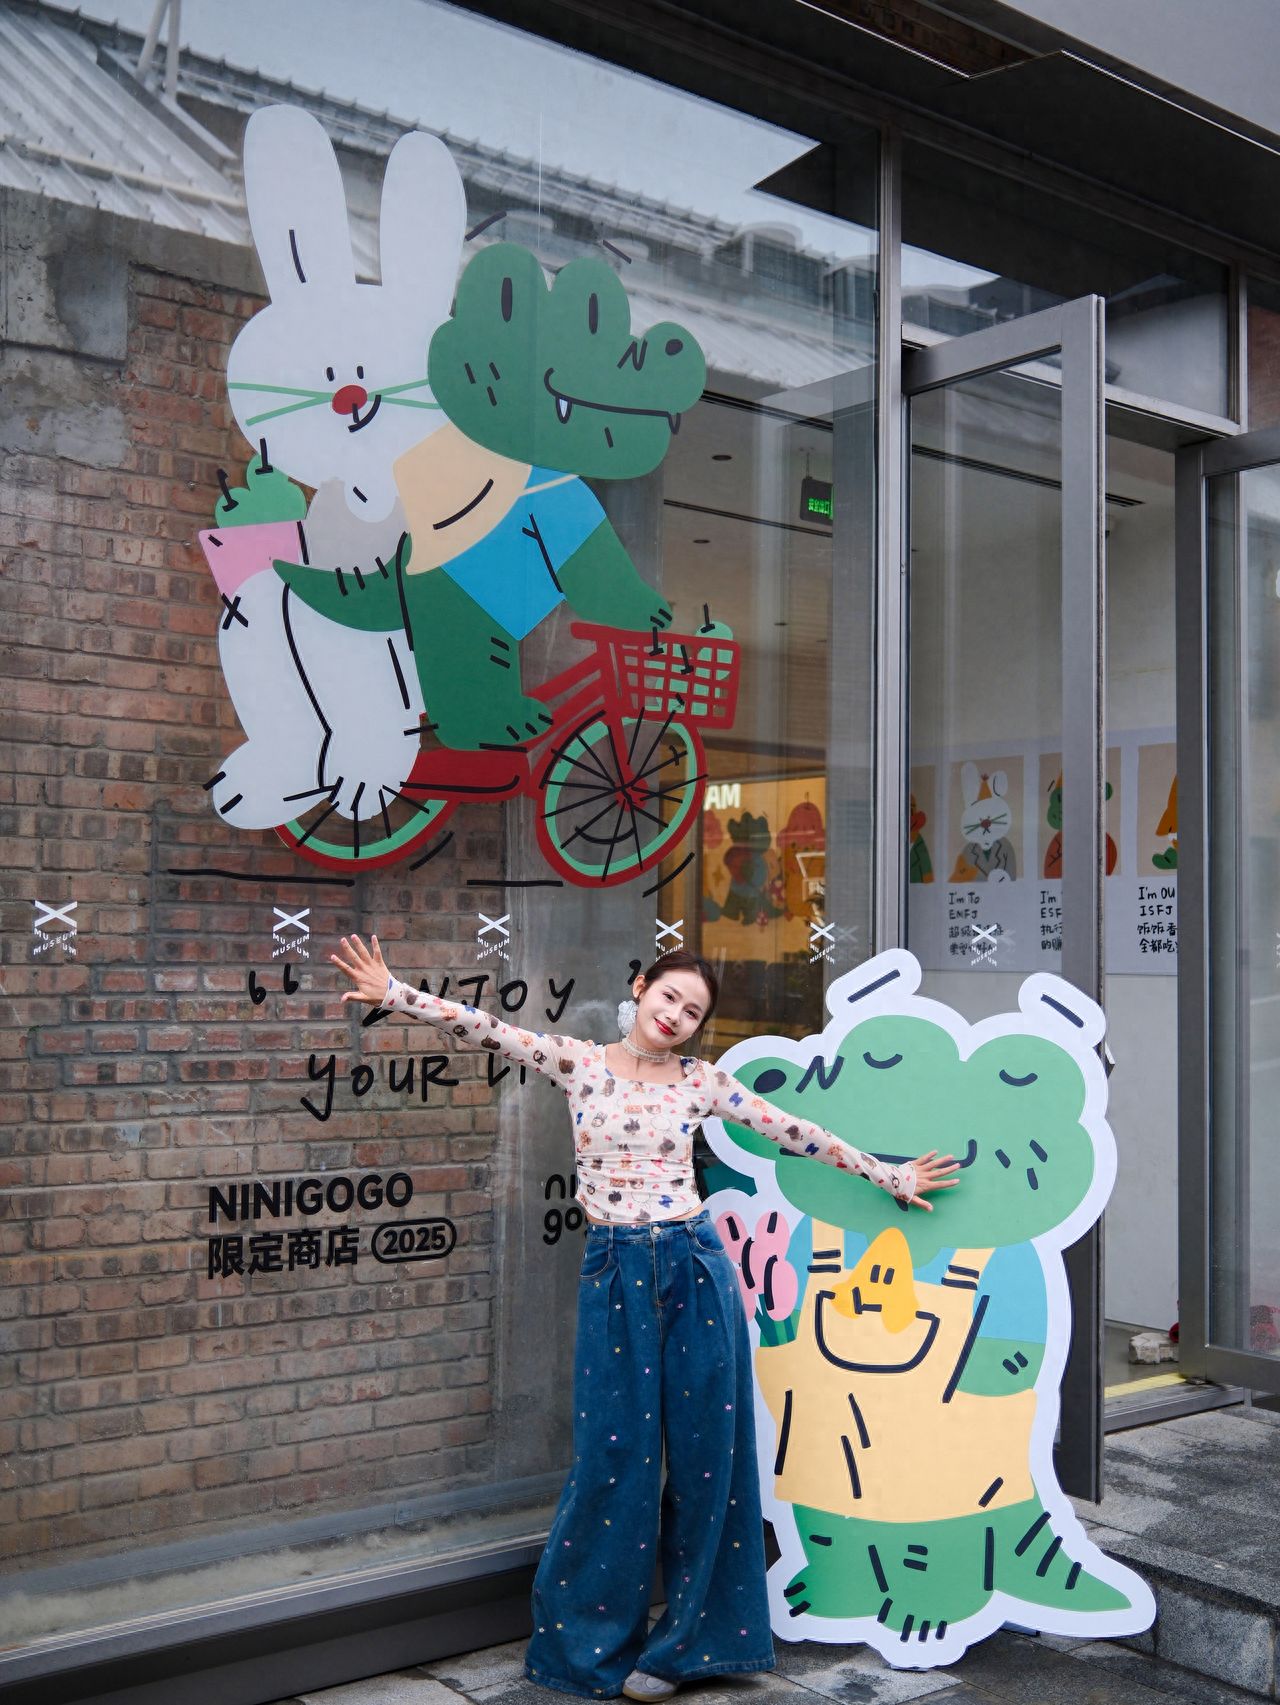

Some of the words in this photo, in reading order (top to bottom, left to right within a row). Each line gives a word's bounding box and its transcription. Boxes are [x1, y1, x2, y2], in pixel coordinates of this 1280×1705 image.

[1138, 886, 1157, 900] I'm
[1040, 907, 1062, 919] ESF
[1140, 905, 1173, 917] ISFJ
[1140, 938, 1179, 954] 全都吃
[208, 1172, 414, 1224] NINIGOGO
[207, 1224, 361, 1280] 限定商店
[382, 1225, 447, 1256] 2025
